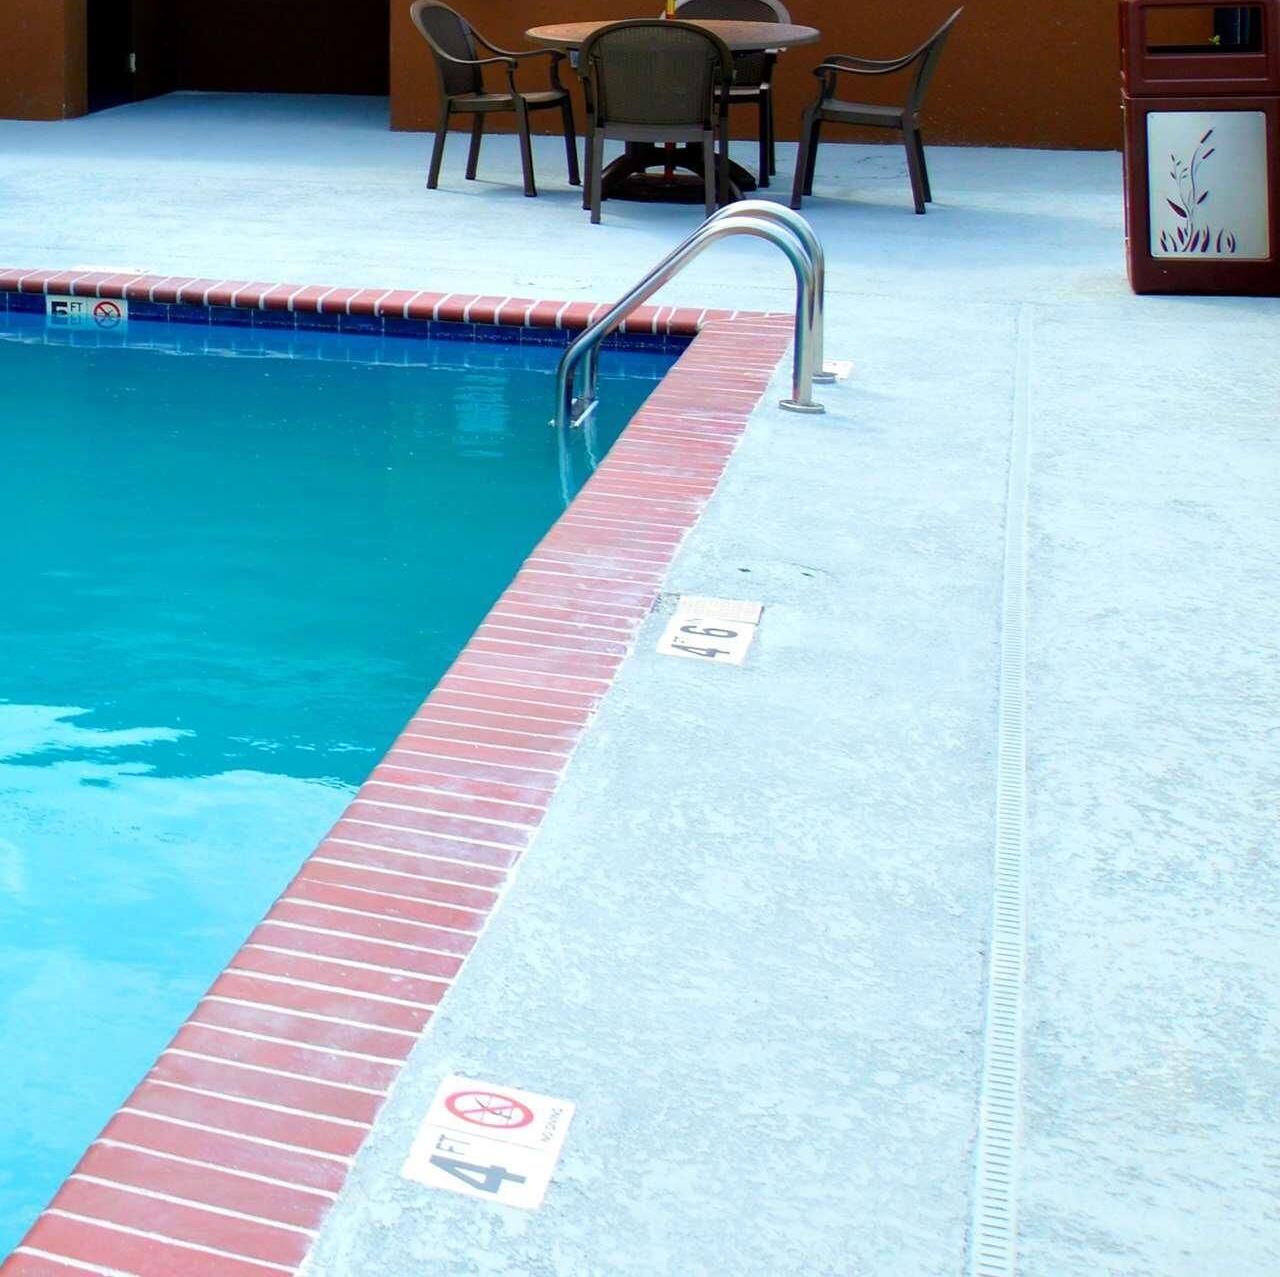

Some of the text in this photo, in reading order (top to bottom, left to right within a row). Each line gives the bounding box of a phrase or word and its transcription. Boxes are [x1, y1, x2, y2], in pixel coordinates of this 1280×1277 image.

[51, 301, 83, 315] 5 FT
[671, 625, 738, 658] 4 6
[428, 1133, 527, 1194] 4 FT
